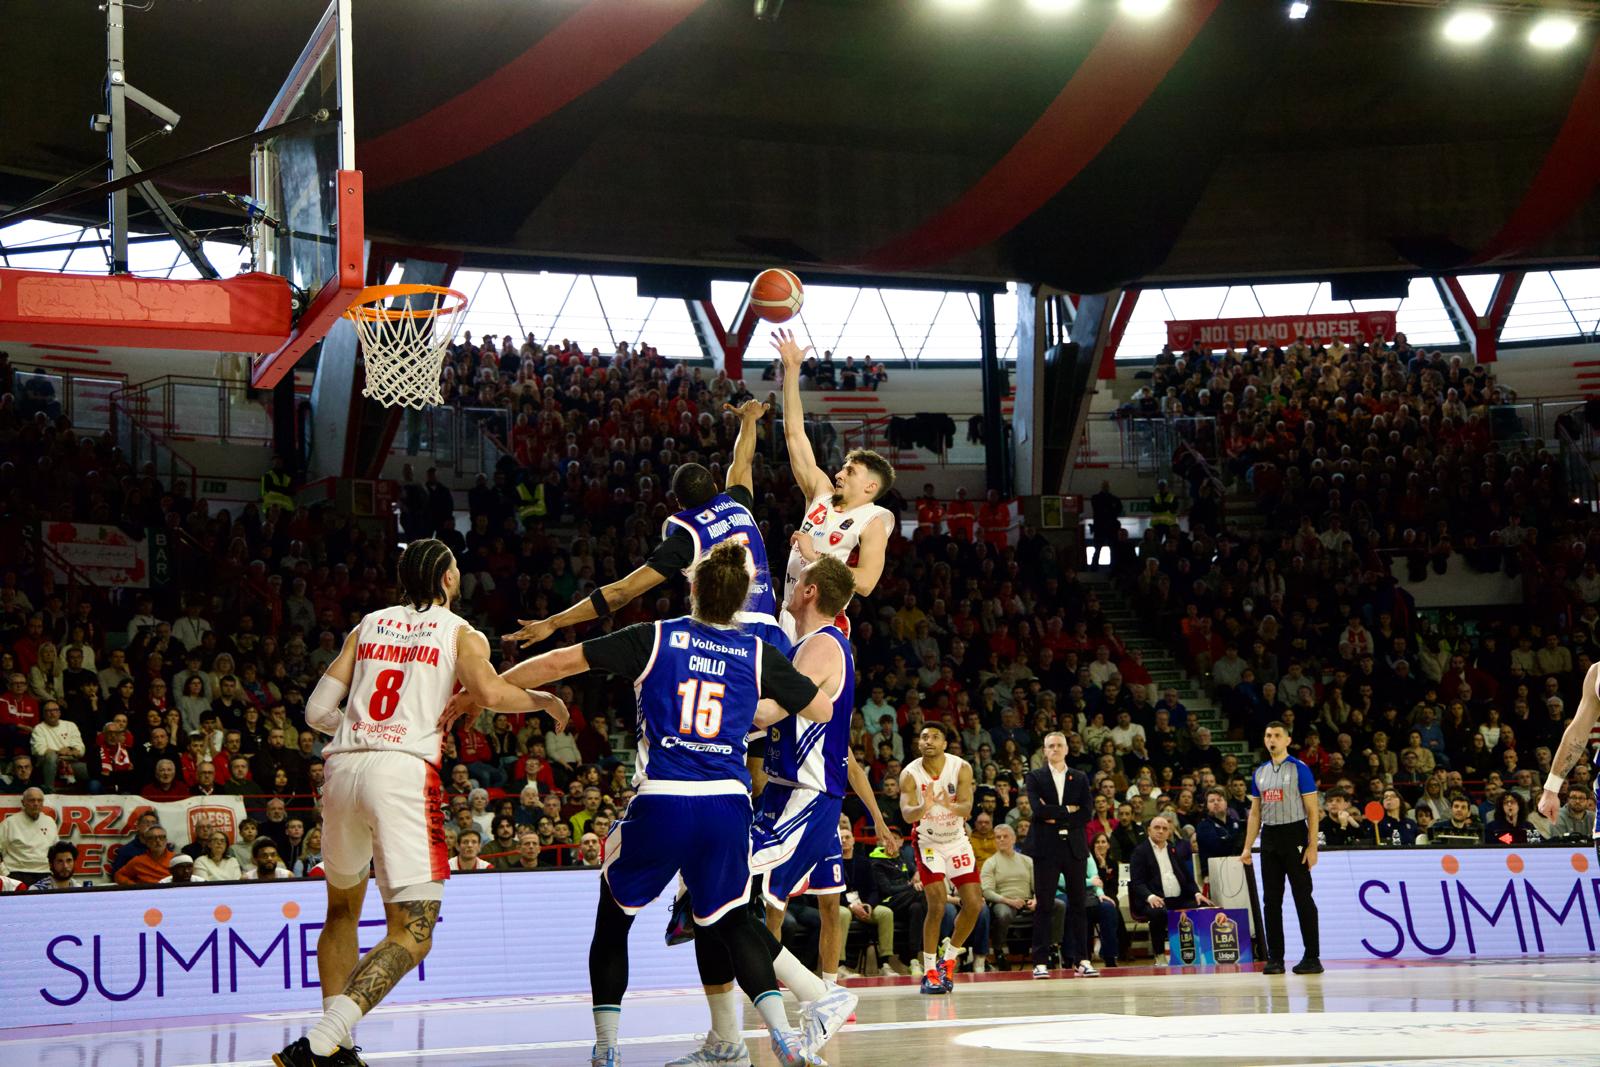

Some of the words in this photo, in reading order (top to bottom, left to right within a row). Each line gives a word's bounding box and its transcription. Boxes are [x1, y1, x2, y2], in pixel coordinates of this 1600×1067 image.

[1200, 326, 1229, 342] NOI
[1233, 323, 1288, 340] SIAMO
[1293, 319, 1360, 338] VARESE
[155, 533, 168, 575] BAR
[357, 643, 440, 667] NKAMHOUA
[692, 638, 748, 657] Volksbank
[689, 655, 725, 676] CHILLO
[368, 669, 404, 721] 8
[677, 679, 726, 738] 15
[0, 806, 157, 836] RZA
[952, 854, 971, 869] 55
[832, 864, 842, 883] 9
[1215, 934, 1235, 943] LBA
[40, 916, 443, 1007] SUMME
[1218, 951, 1235, 960] Unipol
